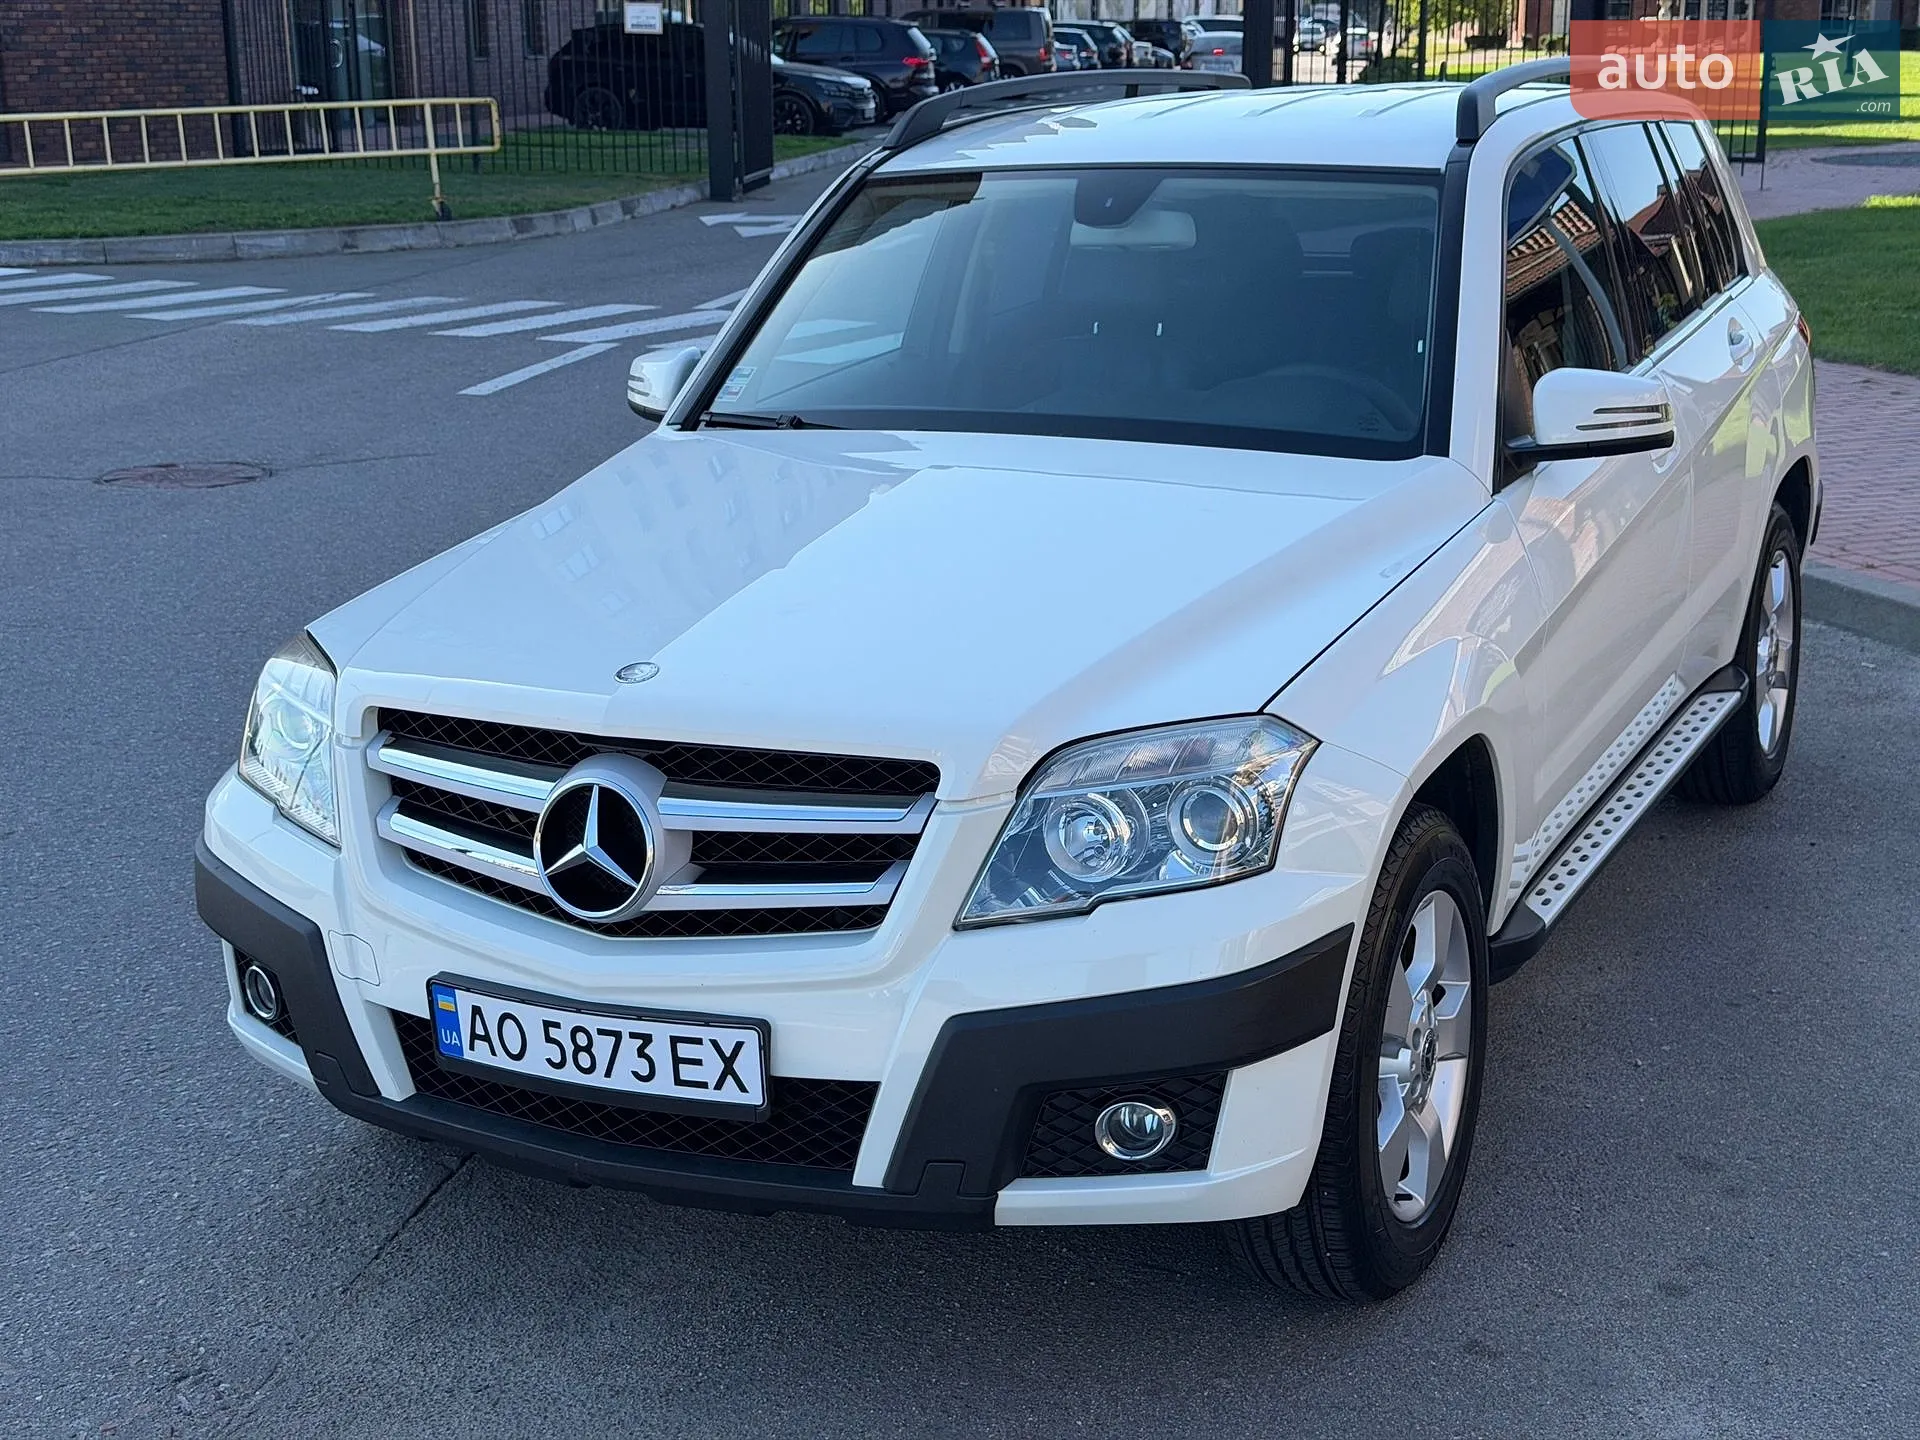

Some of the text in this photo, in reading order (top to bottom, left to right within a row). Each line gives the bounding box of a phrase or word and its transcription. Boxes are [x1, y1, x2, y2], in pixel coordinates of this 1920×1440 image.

[441, 1027, 461, 1047] UA
[468, 1004, 750, 1094] AO 5873 EX
